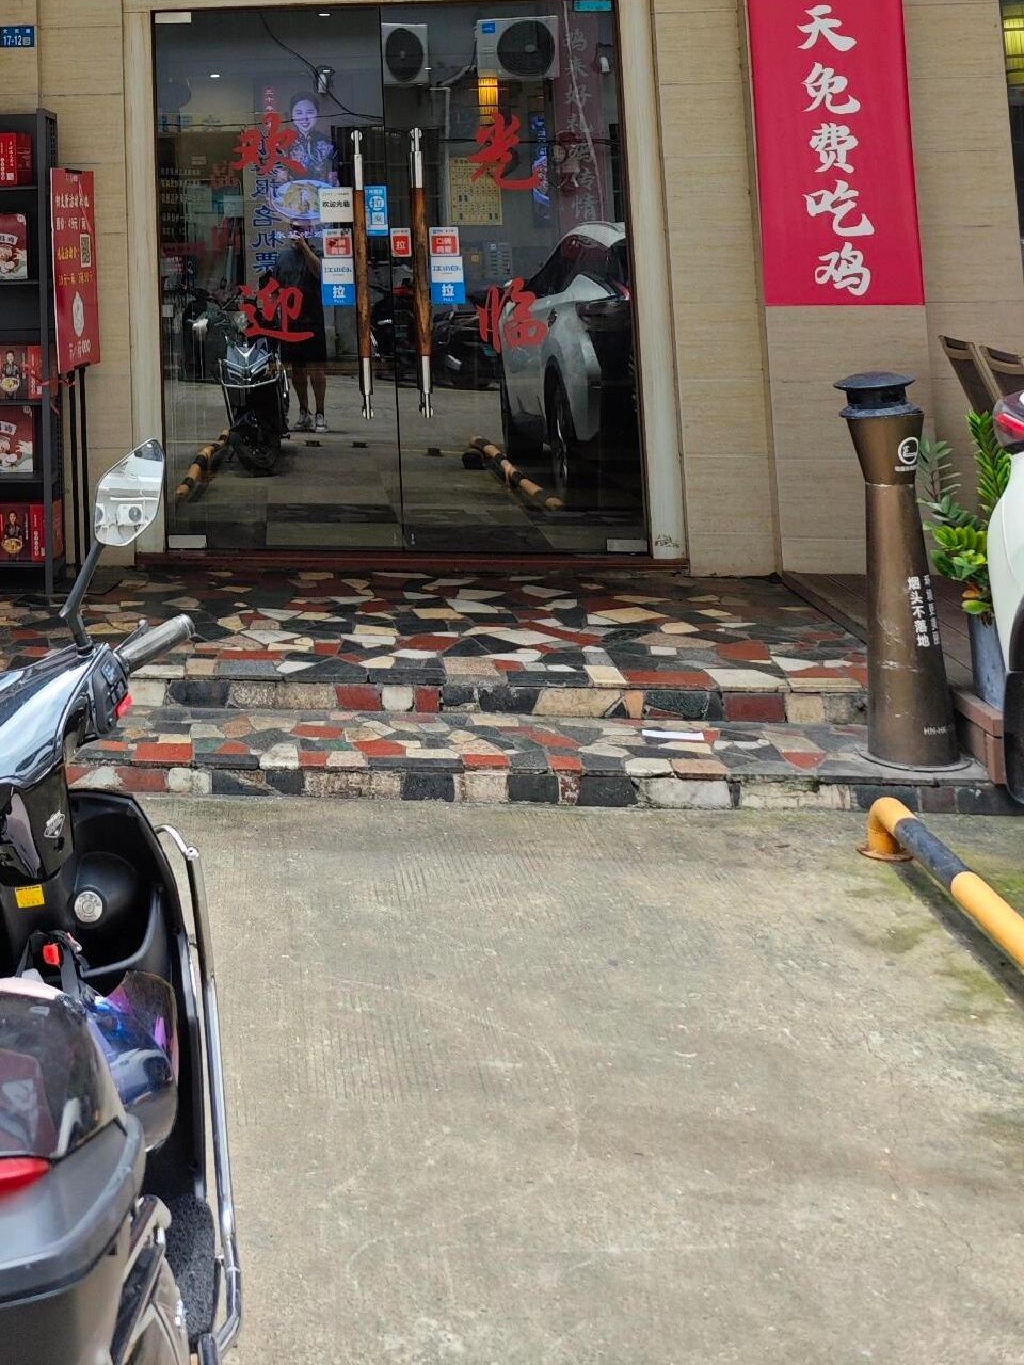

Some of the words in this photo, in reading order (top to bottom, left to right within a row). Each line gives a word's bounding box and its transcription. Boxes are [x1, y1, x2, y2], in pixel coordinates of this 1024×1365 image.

[333, 285, 346, 299] 拉
[442, 284, 455, 296] 拉
[907, 576, 930, 647] 烟头不落地
